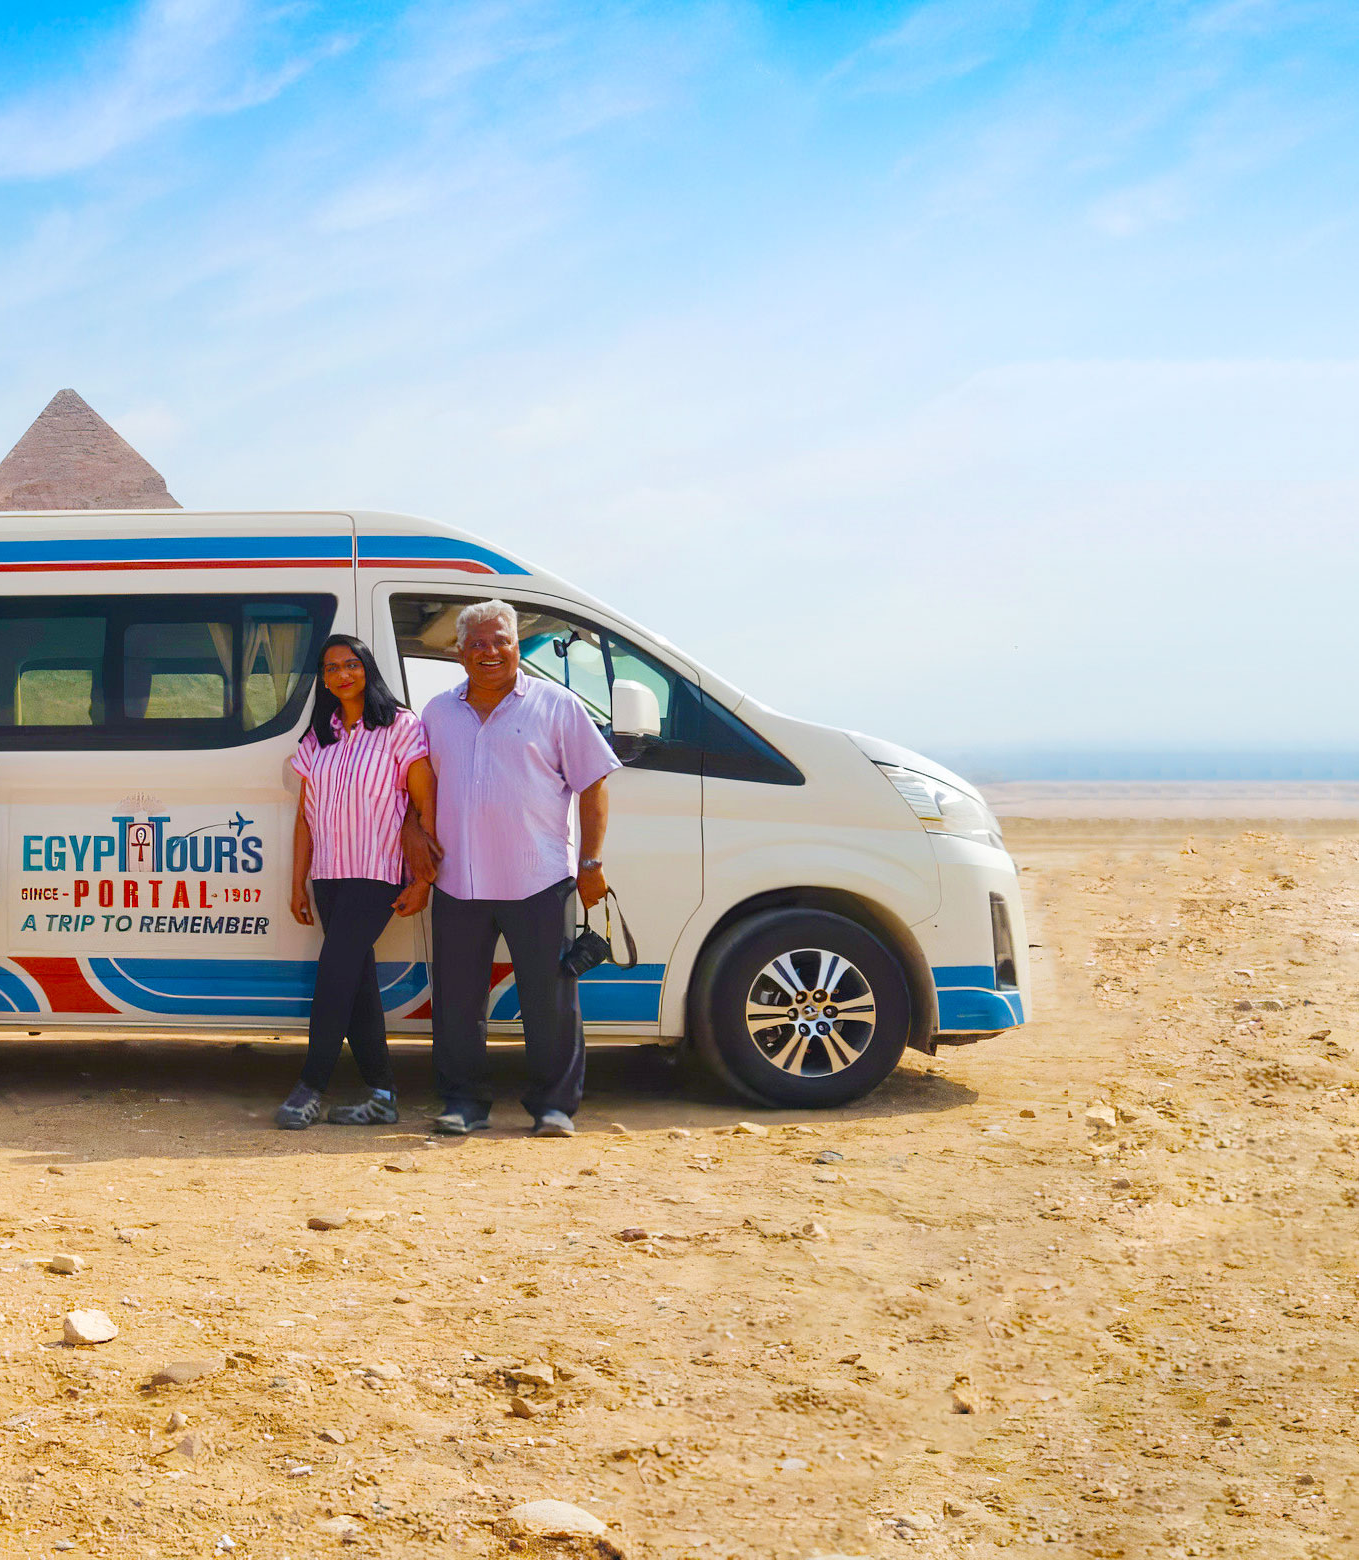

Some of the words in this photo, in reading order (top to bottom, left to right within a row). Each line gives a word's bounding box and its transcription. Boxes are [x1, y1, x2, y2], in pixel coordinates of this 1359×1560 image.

[22, 816, 134, 873] EGYPT
[148, 816, 263, 873] TOURS
[74, 879, 213, 909] PORTAL
[21, 914, 38, 932] A
[46, 914, 96, 933] TRIP
[101, 914, 133, 933] TO
[139, 915, 270, 935] REMEMBER
